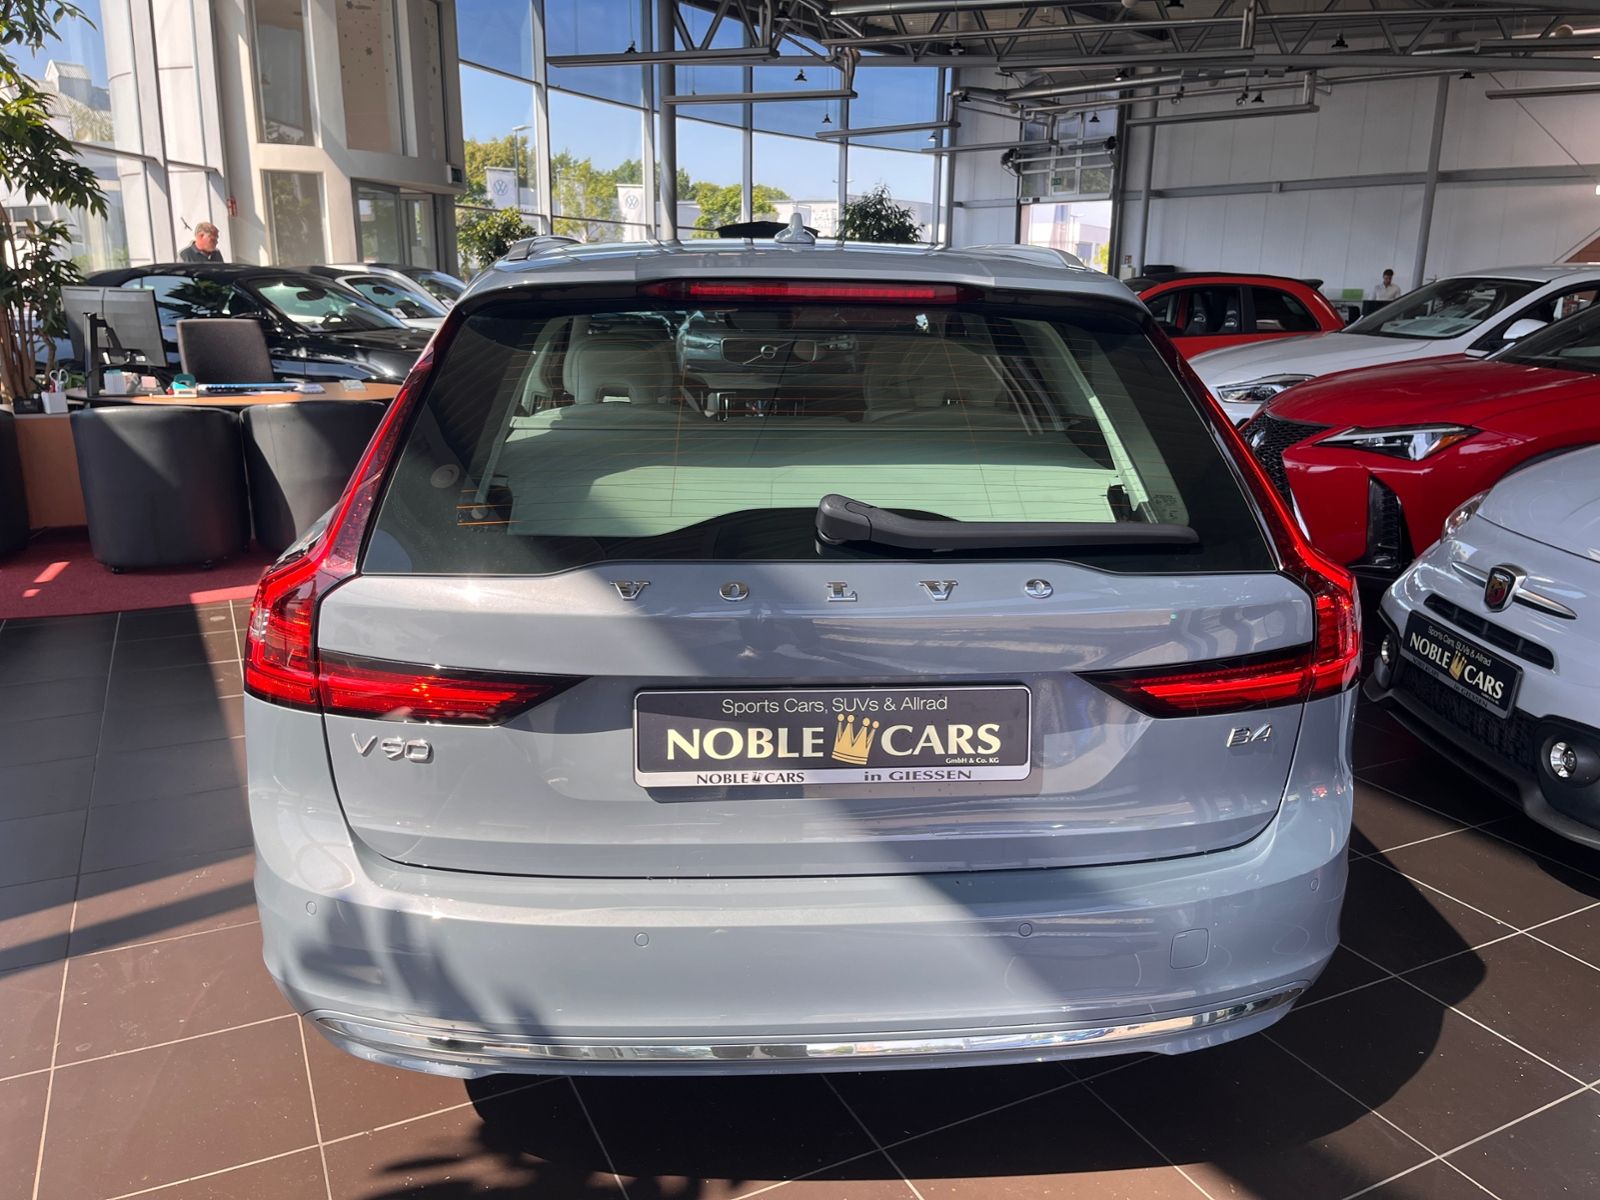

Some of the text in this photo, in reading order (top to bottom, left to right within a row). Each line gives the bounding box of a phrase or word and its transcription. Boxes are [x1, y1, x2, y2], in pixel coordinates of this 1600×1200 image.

[610, 578, 1054, 602] VOLVO
[1409, 631, 1452, 669] NOBLE
[1463, 665, 1504, 699] CARS
[722, 696, 948, 716] Sports Cars, SUVs & Allrad
[351, 733, 432, 762] V90
[667, 723, 1001, 760] NOBLE CARS
[1226, 724, 1271, 748] B4
[696, 769, 972, 785] NOBLE CARS in GIESSEN
